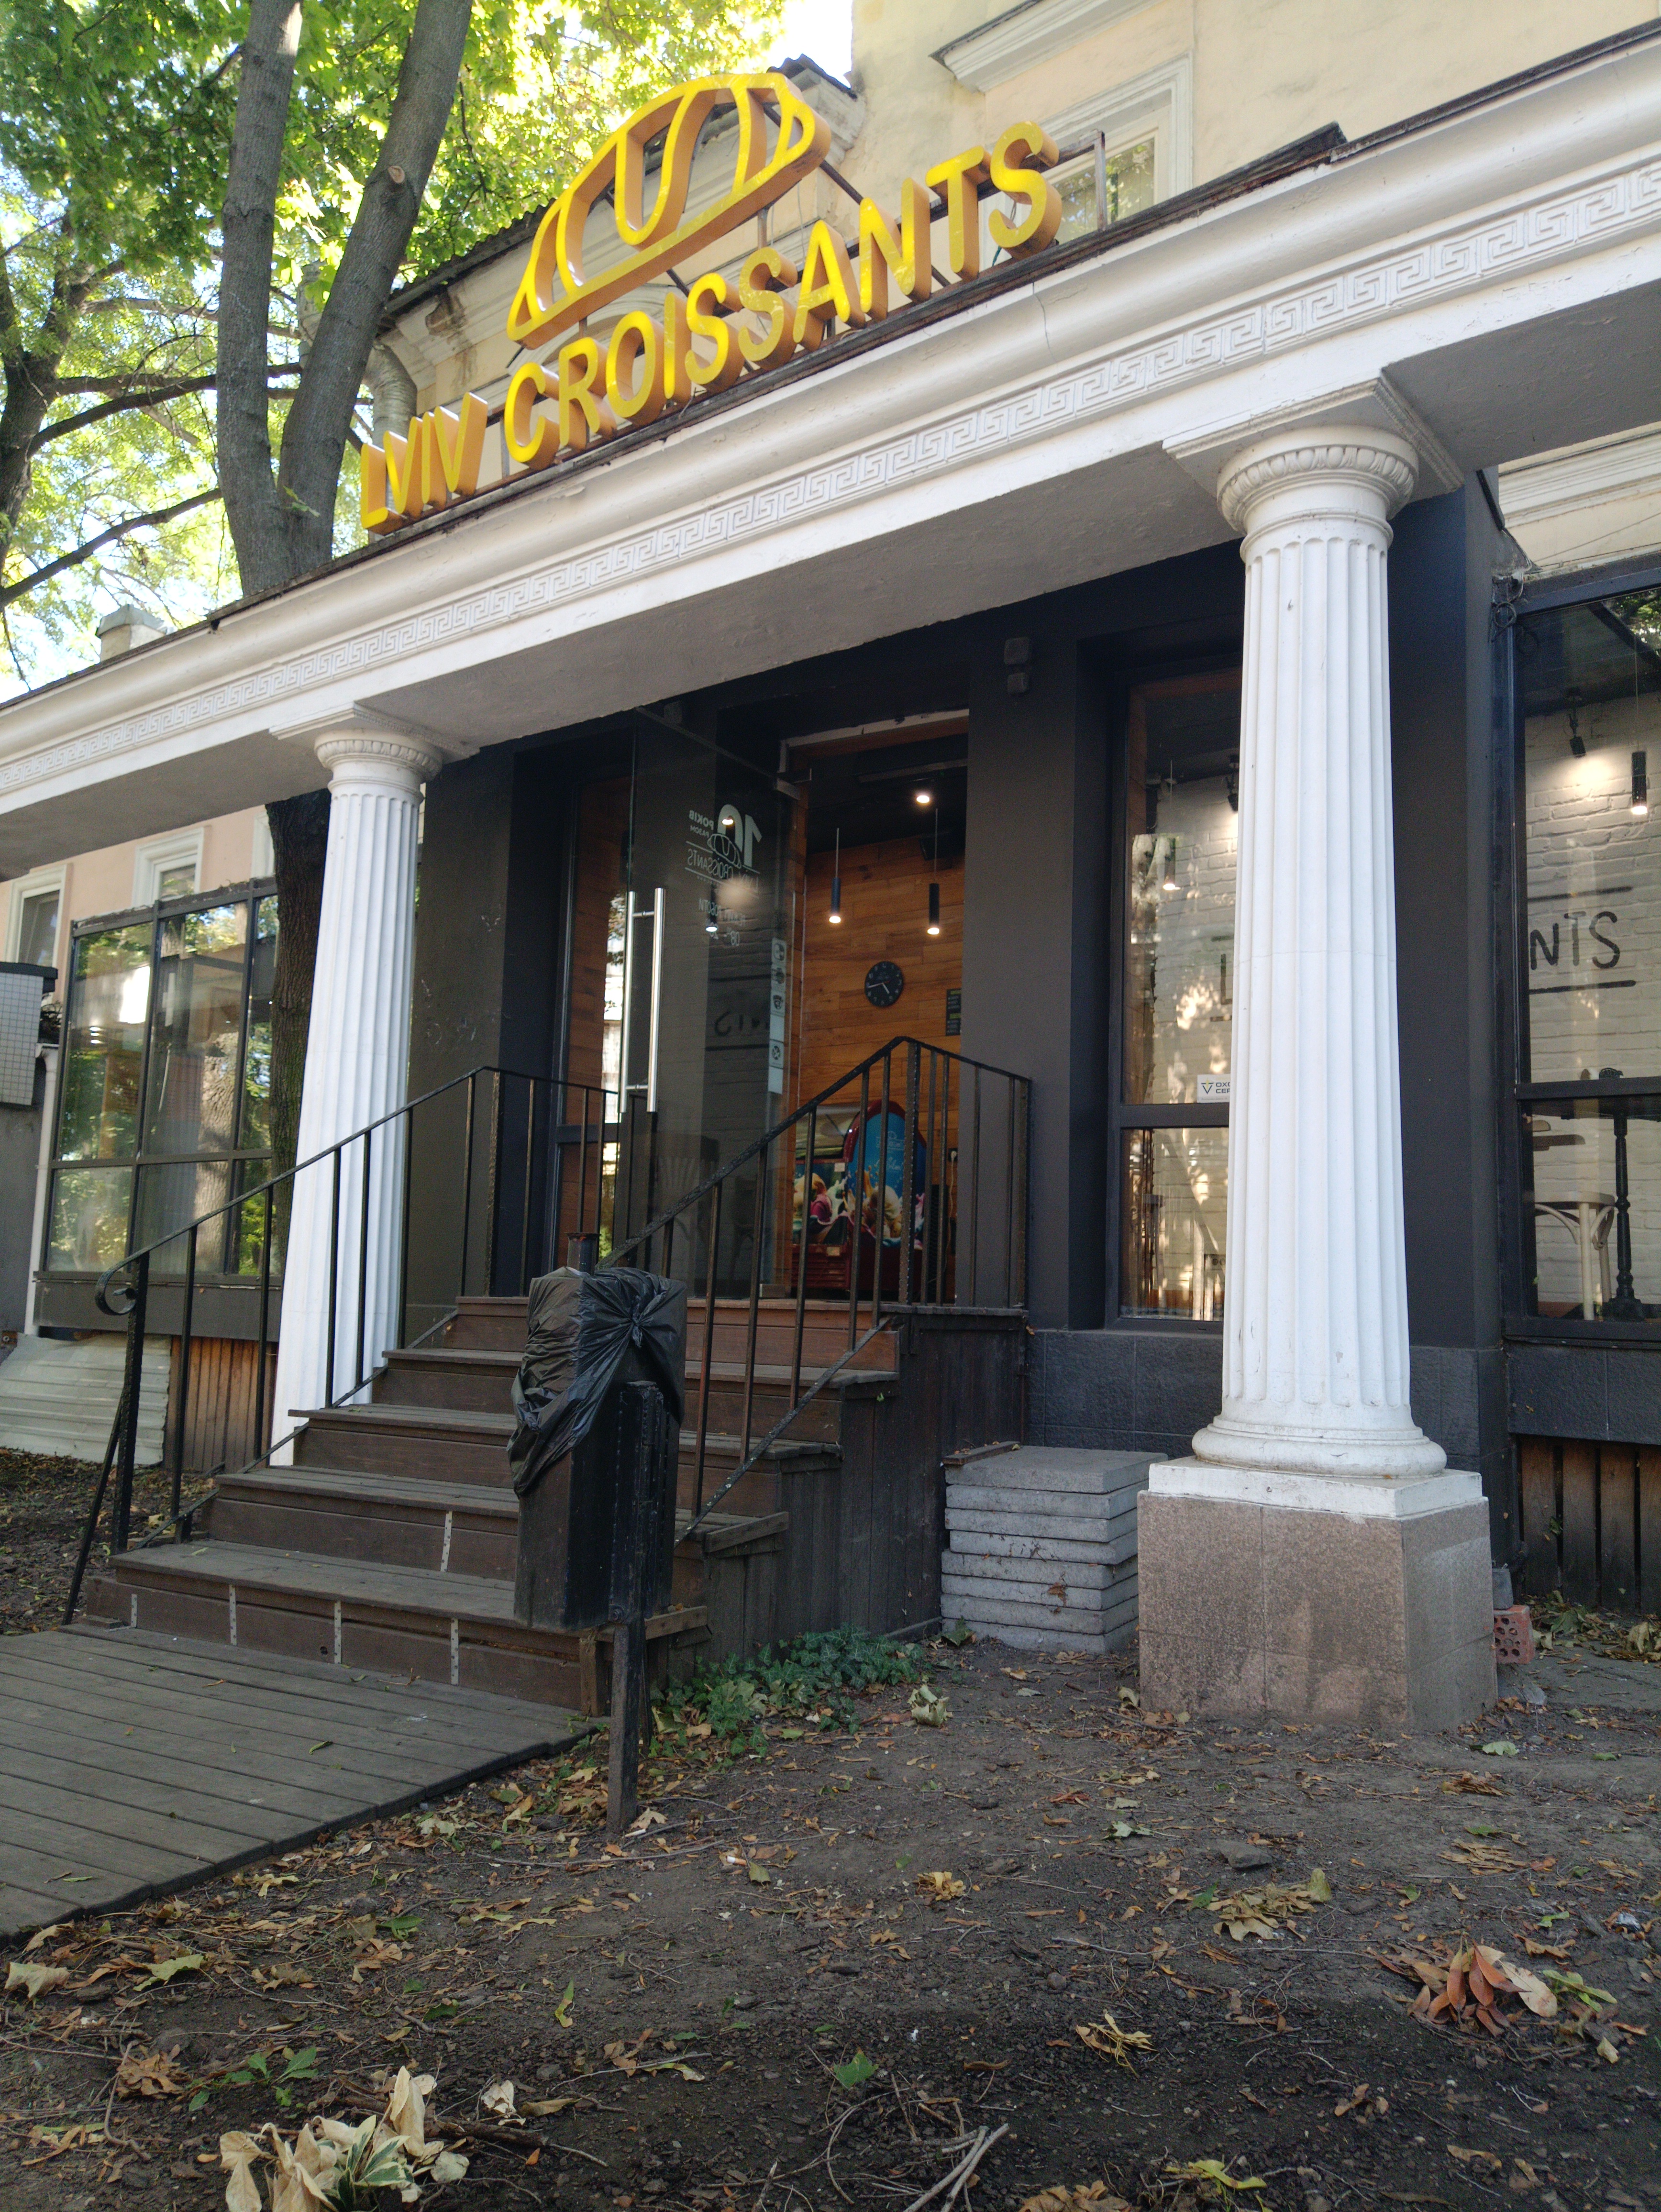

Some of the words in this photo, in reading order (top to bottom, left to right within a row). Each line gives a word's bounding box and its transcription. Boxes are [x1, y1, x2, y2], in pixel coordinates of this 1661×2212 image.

[361, 392, 487, 534] LVIV
[505, 121, 1061, 469] CROISSANTS
[1530, 911, 1620, 970] NTS
